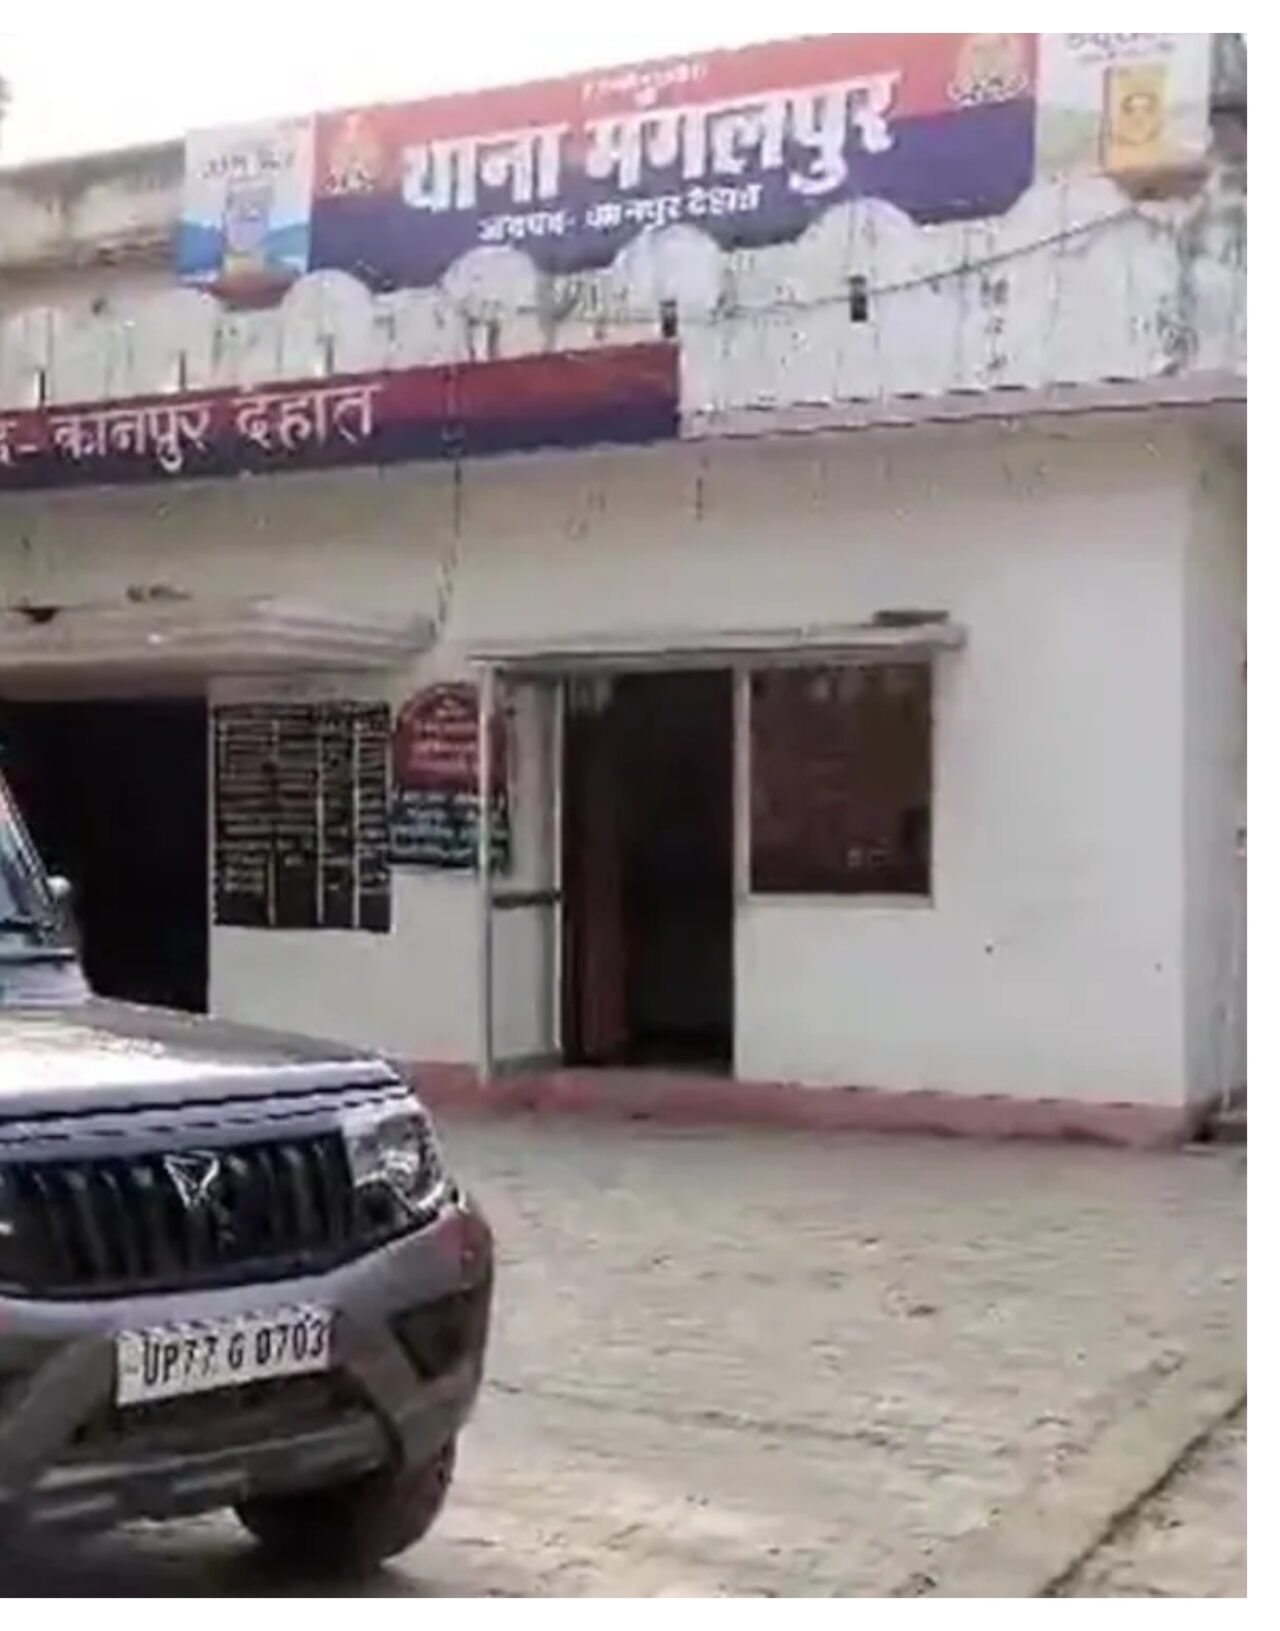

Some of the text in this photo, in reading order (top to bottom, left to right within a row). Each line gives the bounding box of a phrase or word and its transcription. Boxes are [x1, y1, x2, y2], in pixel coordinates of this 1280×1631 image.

[403, 123, 569, 212] थाना
[50, 402, 212, 473] कानपुर
[232, 383, 383, 450] देहात
[143, 1315, 325, 1386] UP77 G 0703
